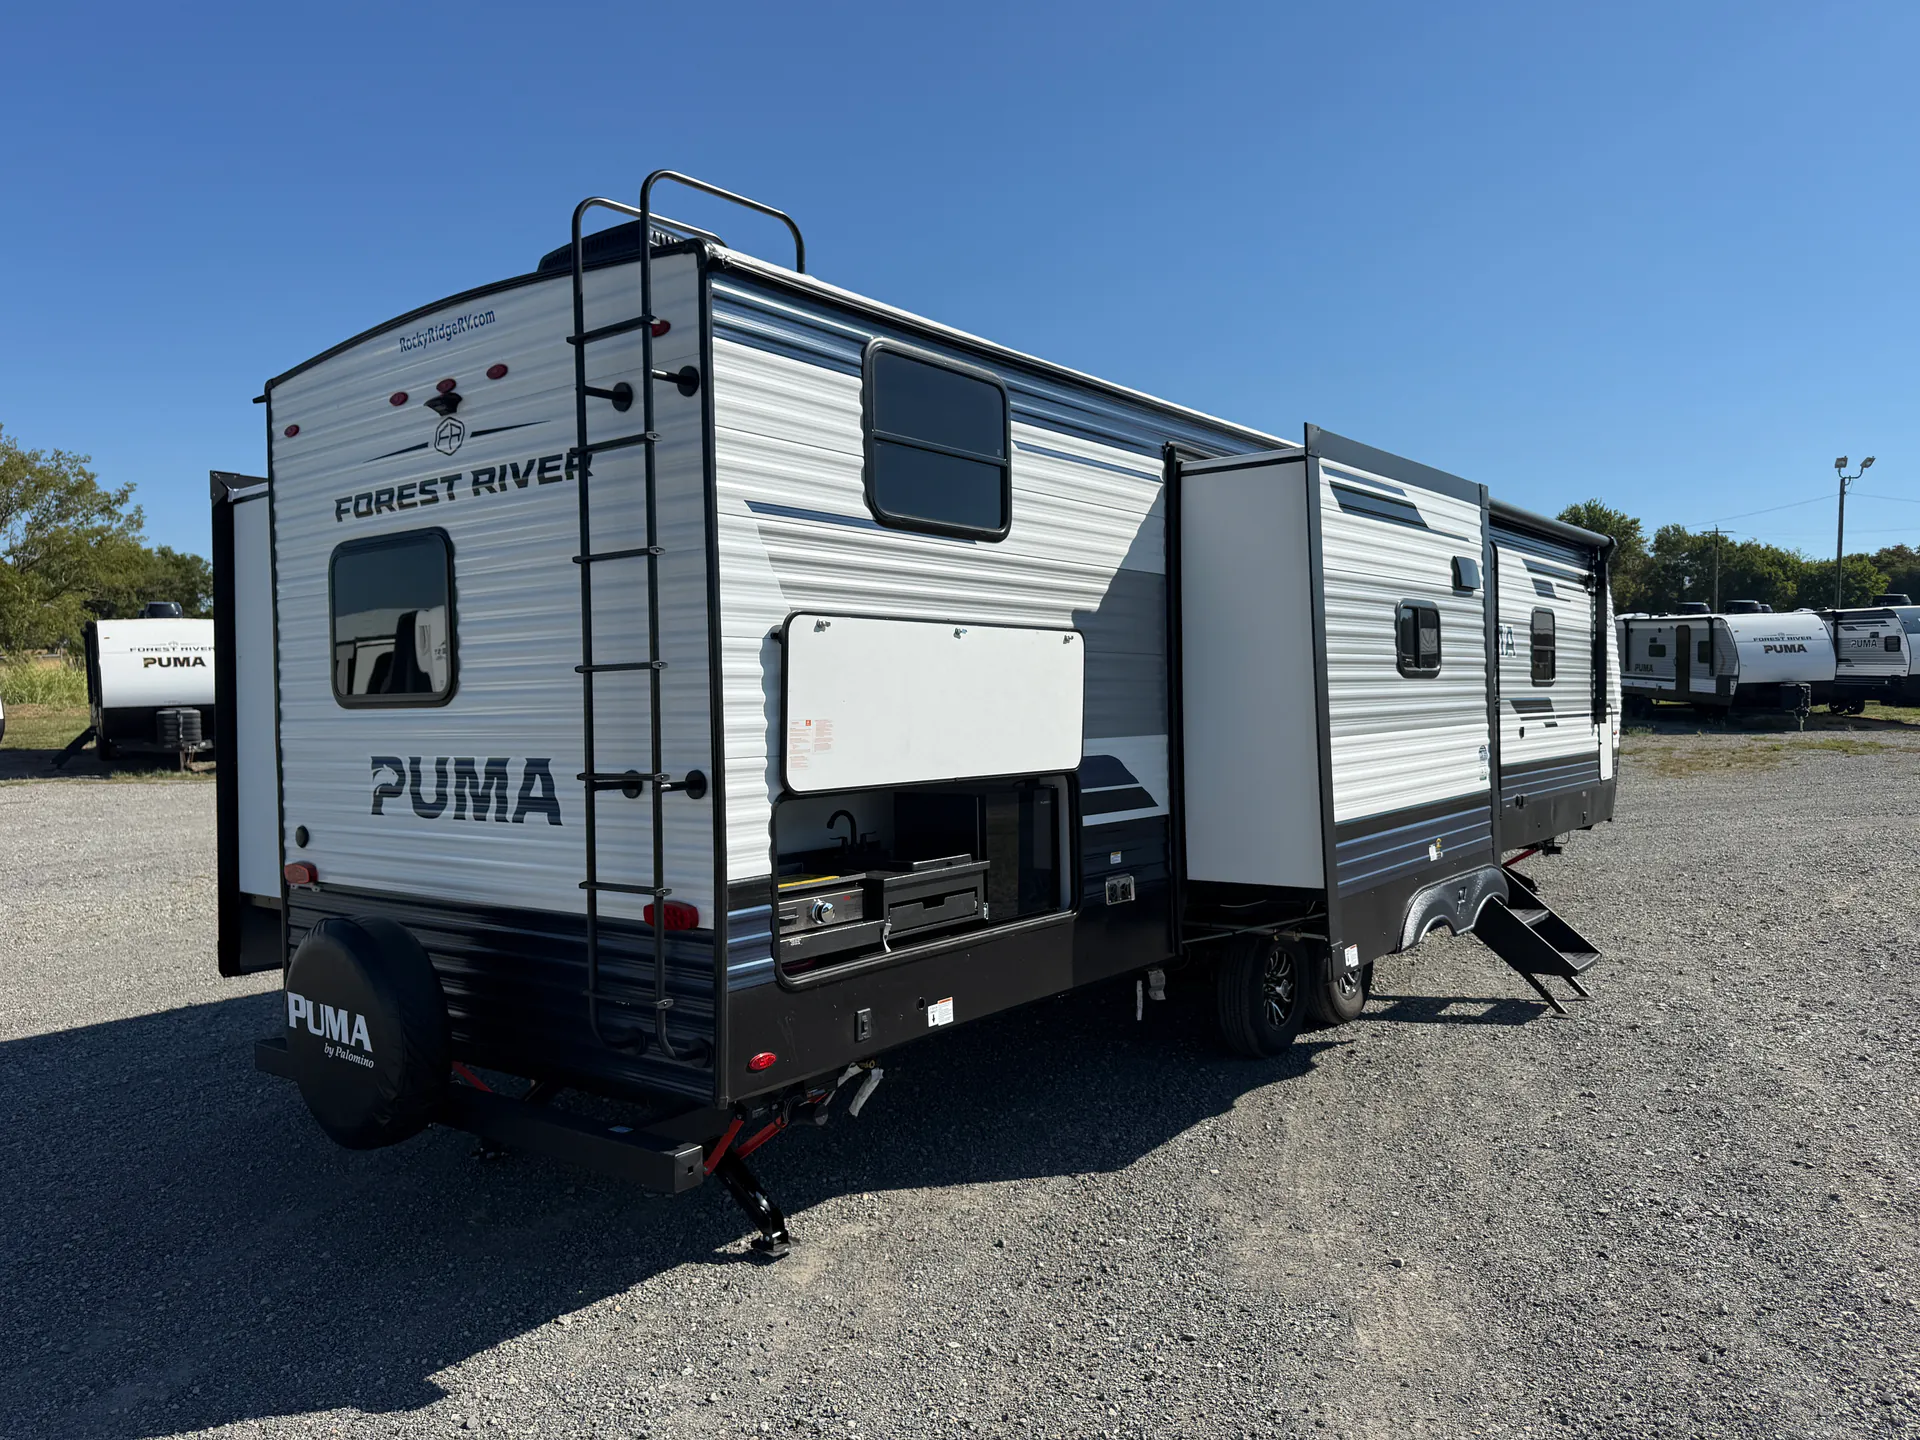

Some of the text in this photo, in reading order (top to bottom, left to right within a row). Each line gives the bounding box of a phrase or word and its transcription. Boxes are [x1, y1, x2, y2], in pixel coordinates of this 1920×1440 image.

[399, 310, 496, 353] RockyRidgeRV.com
[334, 473, 462, 523] FOREST
[1763, 643, 1808, 654] PUMA
[1851, 639, 1878, 648] PUMA
[143, 657, 206, 668] PUMA
[1634, 663, 1653, 672] PUMA
[370, 756, 563, 826] PUMA
[287, 991, 373, 1053] PUMA
[324, 1043, 374, 1068] by Palomino
